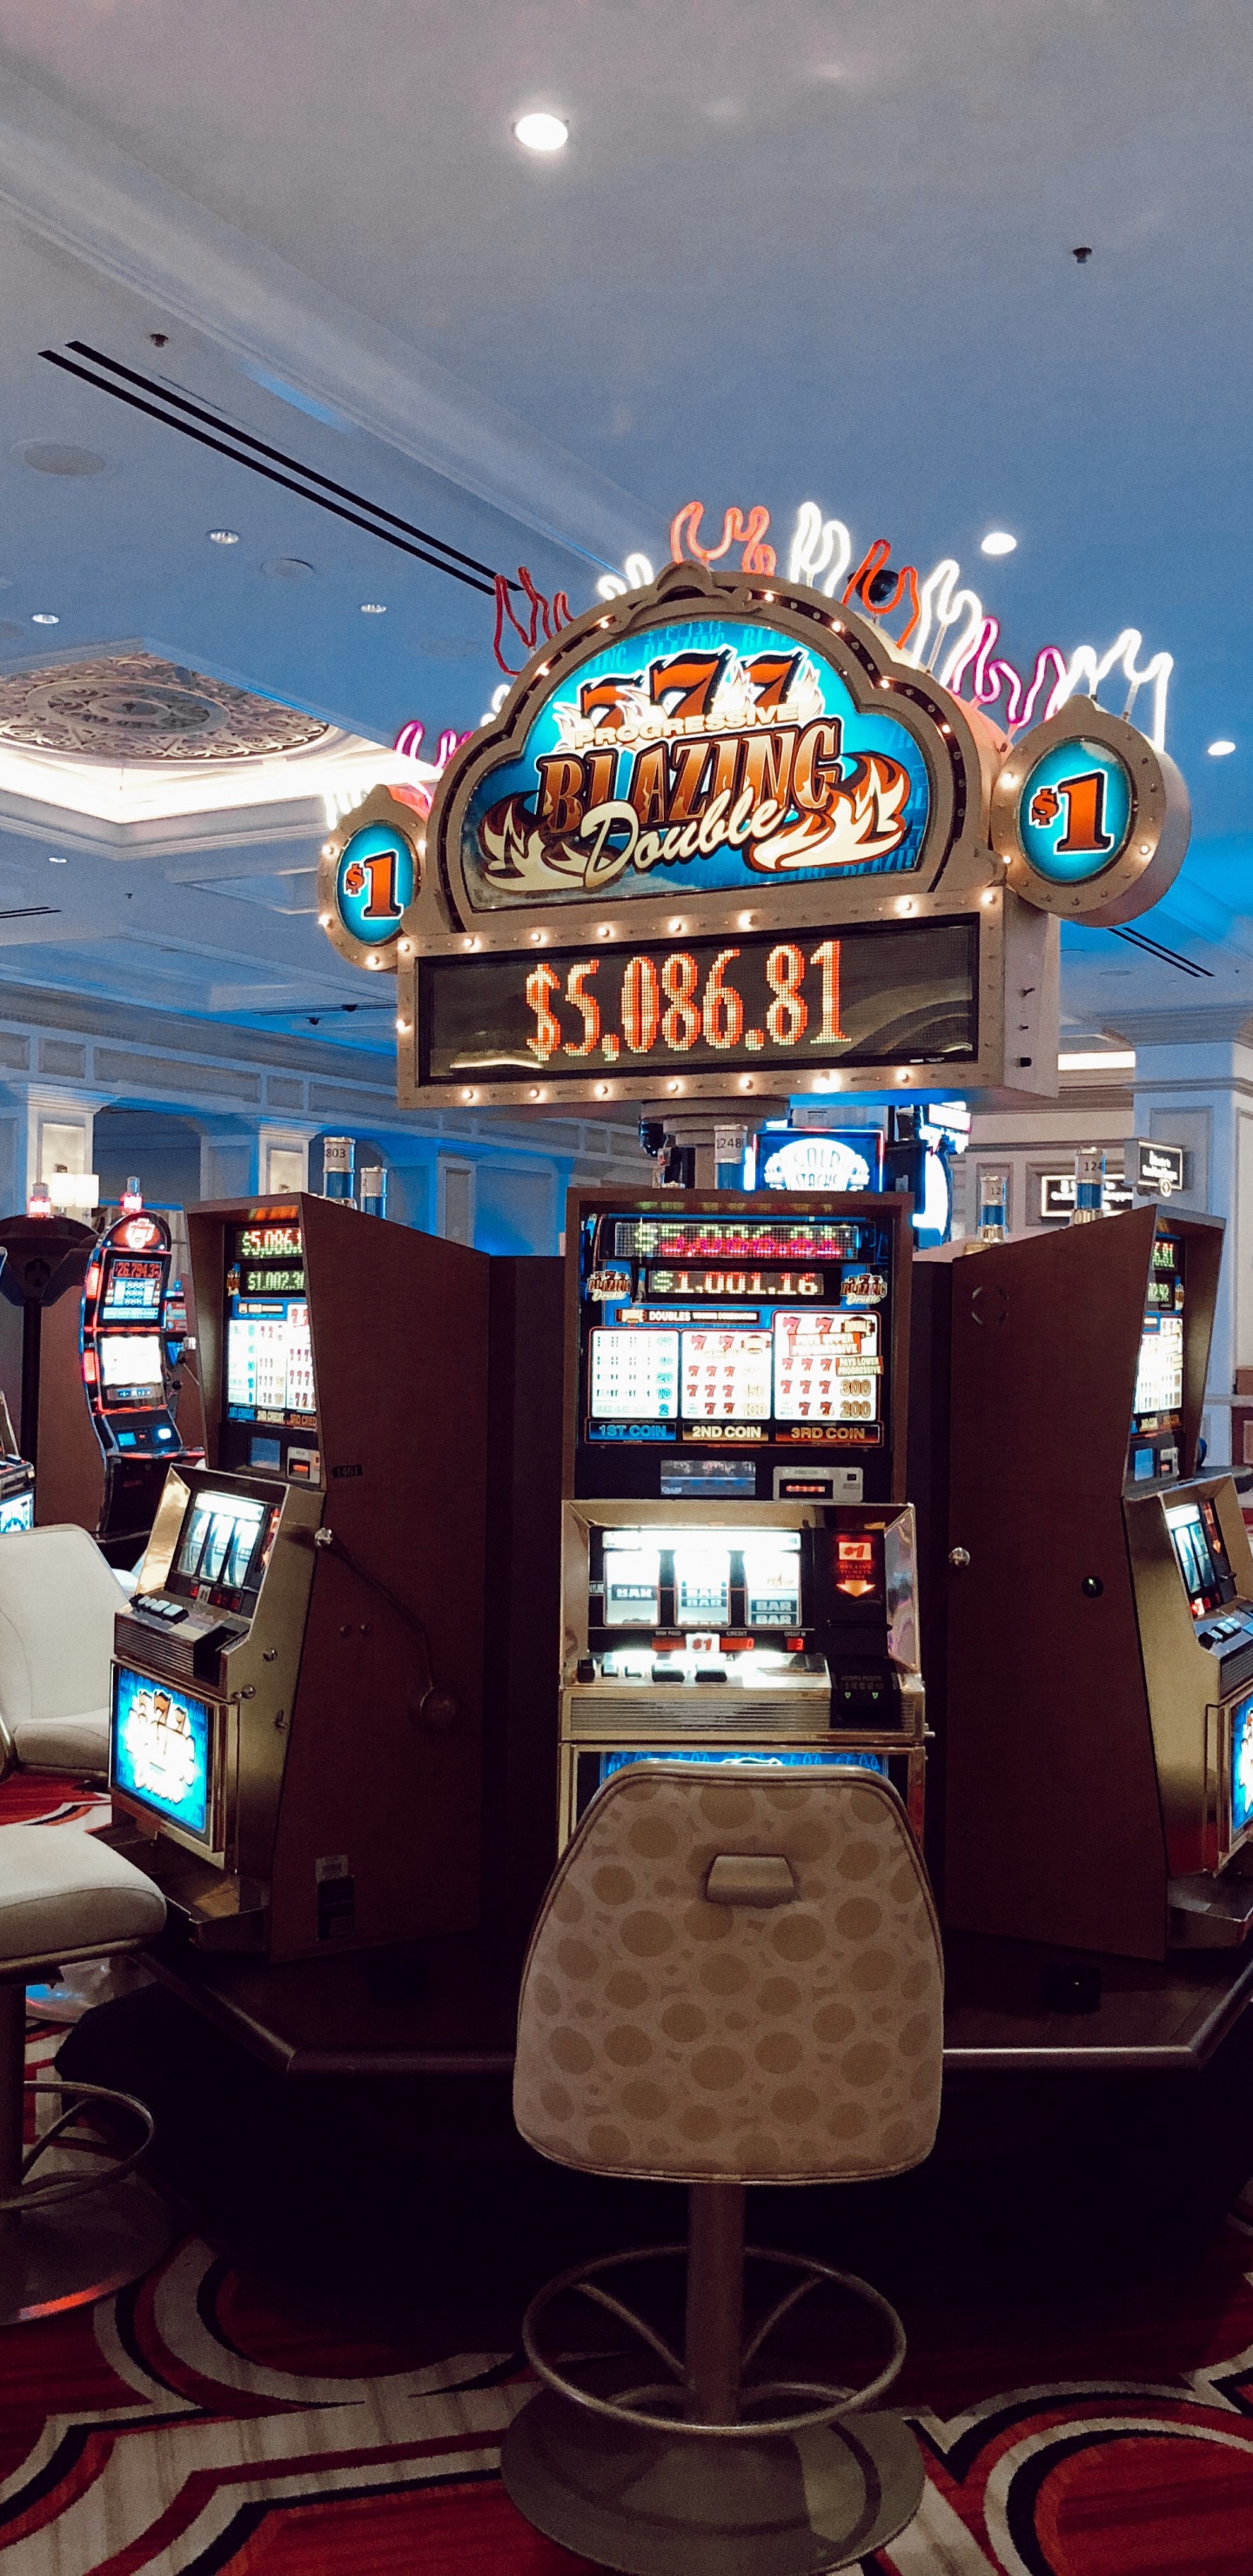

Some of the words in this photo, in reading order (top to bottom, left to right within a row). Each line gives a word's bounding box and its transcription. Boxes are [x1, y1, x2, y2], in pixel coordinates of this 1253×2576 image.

[575, 701, 799, 748] PROGRESSIVE
[536, 721, 841, 834] BLAZING
[1031, 770, 1112, 853] $1
[580, 786, 790, 888] Double
[345, 850, 402, 917] $1
[526, 940, 852, 1062] $5,086.81
[649, 1311, 691, 1322] DOUBLES
[656, 1387, 673, 1400] 10
[841, 1379, 871, 1397] 300
[658, 1404, 670, 1416] 2
[841, 1400, 871, 1419] 200
[599, 1425, 626, 1437] 1ST
[629, 1425, 667, 1437] COIN
[692, 1426, 722, 1438] 2ND
[724, 1426, 762, 1438] COIN
[791, 1427, 823, 1439] 3RD
[826, 1427, 865, 1439] COIN
[756, 1600, 791, 1612] BAR
[756, 1614, 791, 1626] BAR
[691, 1637, 714, 1652] $1
